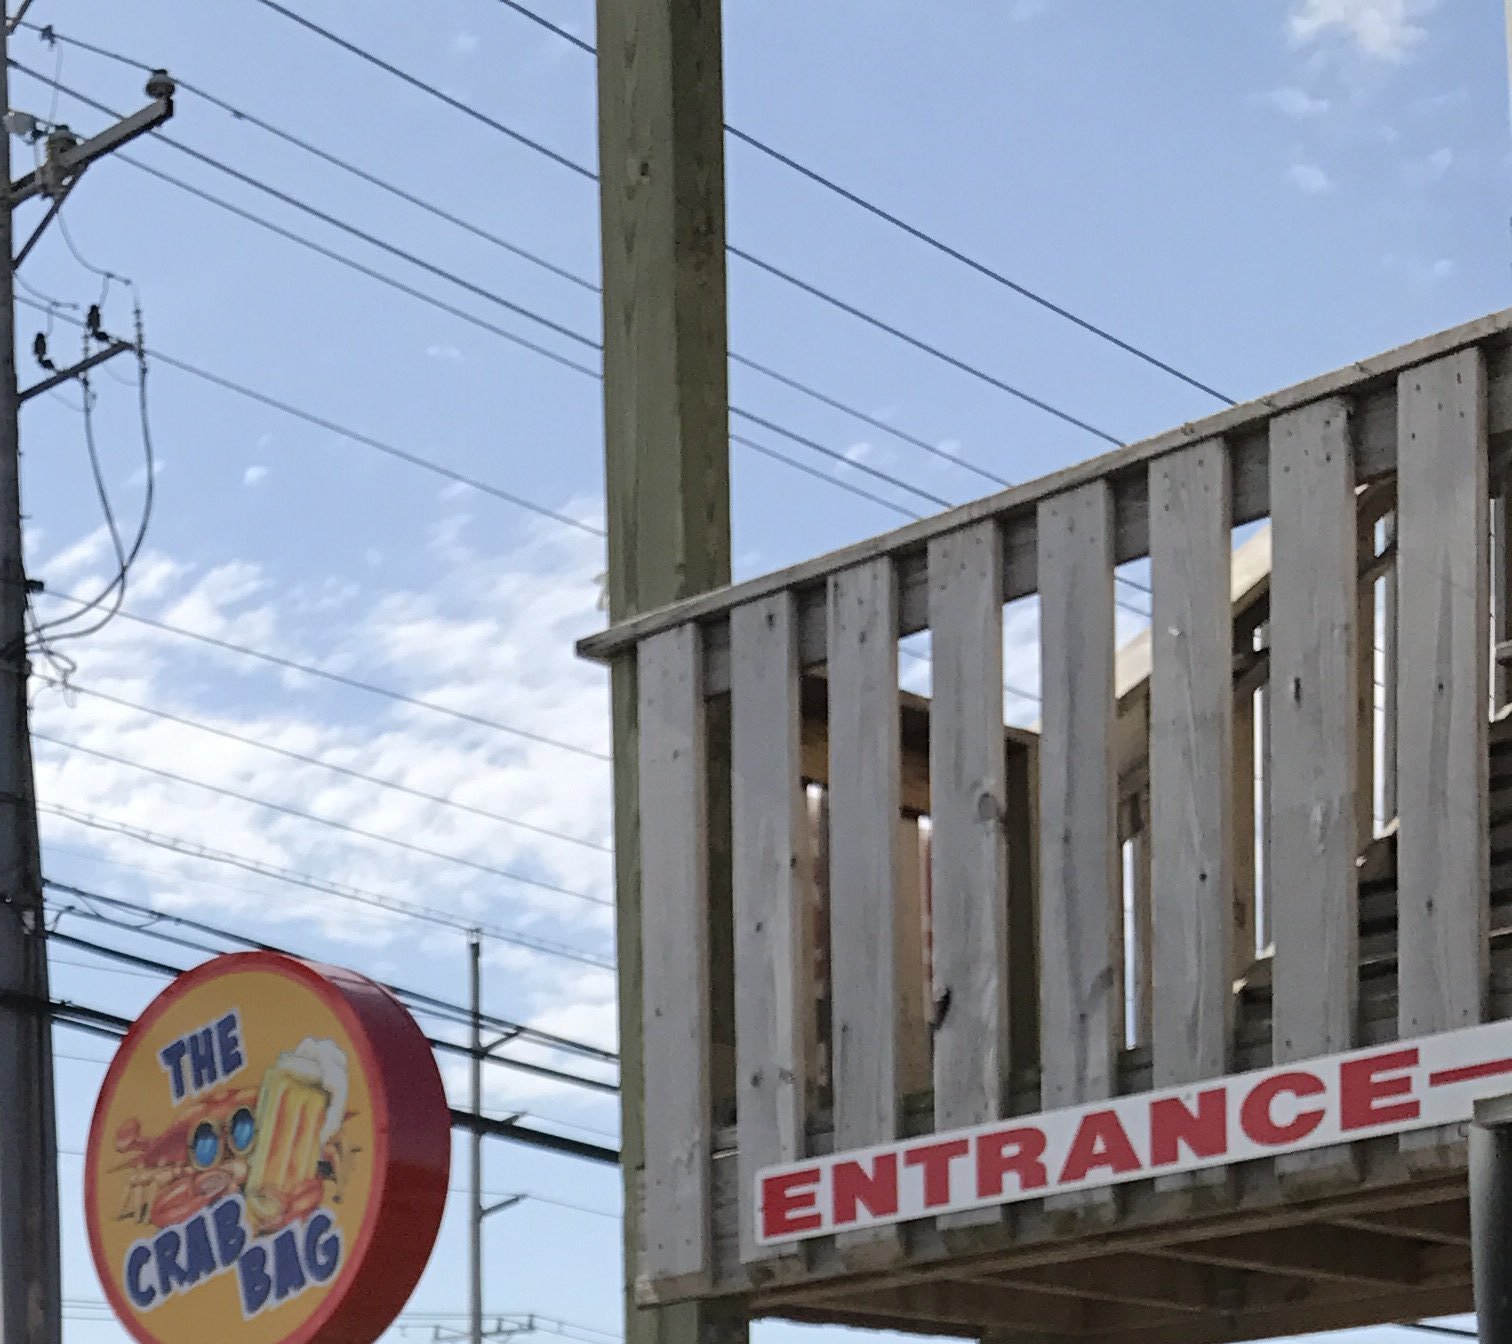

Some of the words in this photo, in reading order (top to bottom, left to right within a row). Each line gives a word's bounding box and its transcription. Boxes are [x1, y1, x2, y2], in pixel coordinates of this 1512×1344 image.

[159, 1010, 245, 1102] THE
[761, 1048, 1420, 1238] ENTRANCE
[125, 1197, 247, 1309] CRAB
[238, 1212, 342, 1316] BAG
